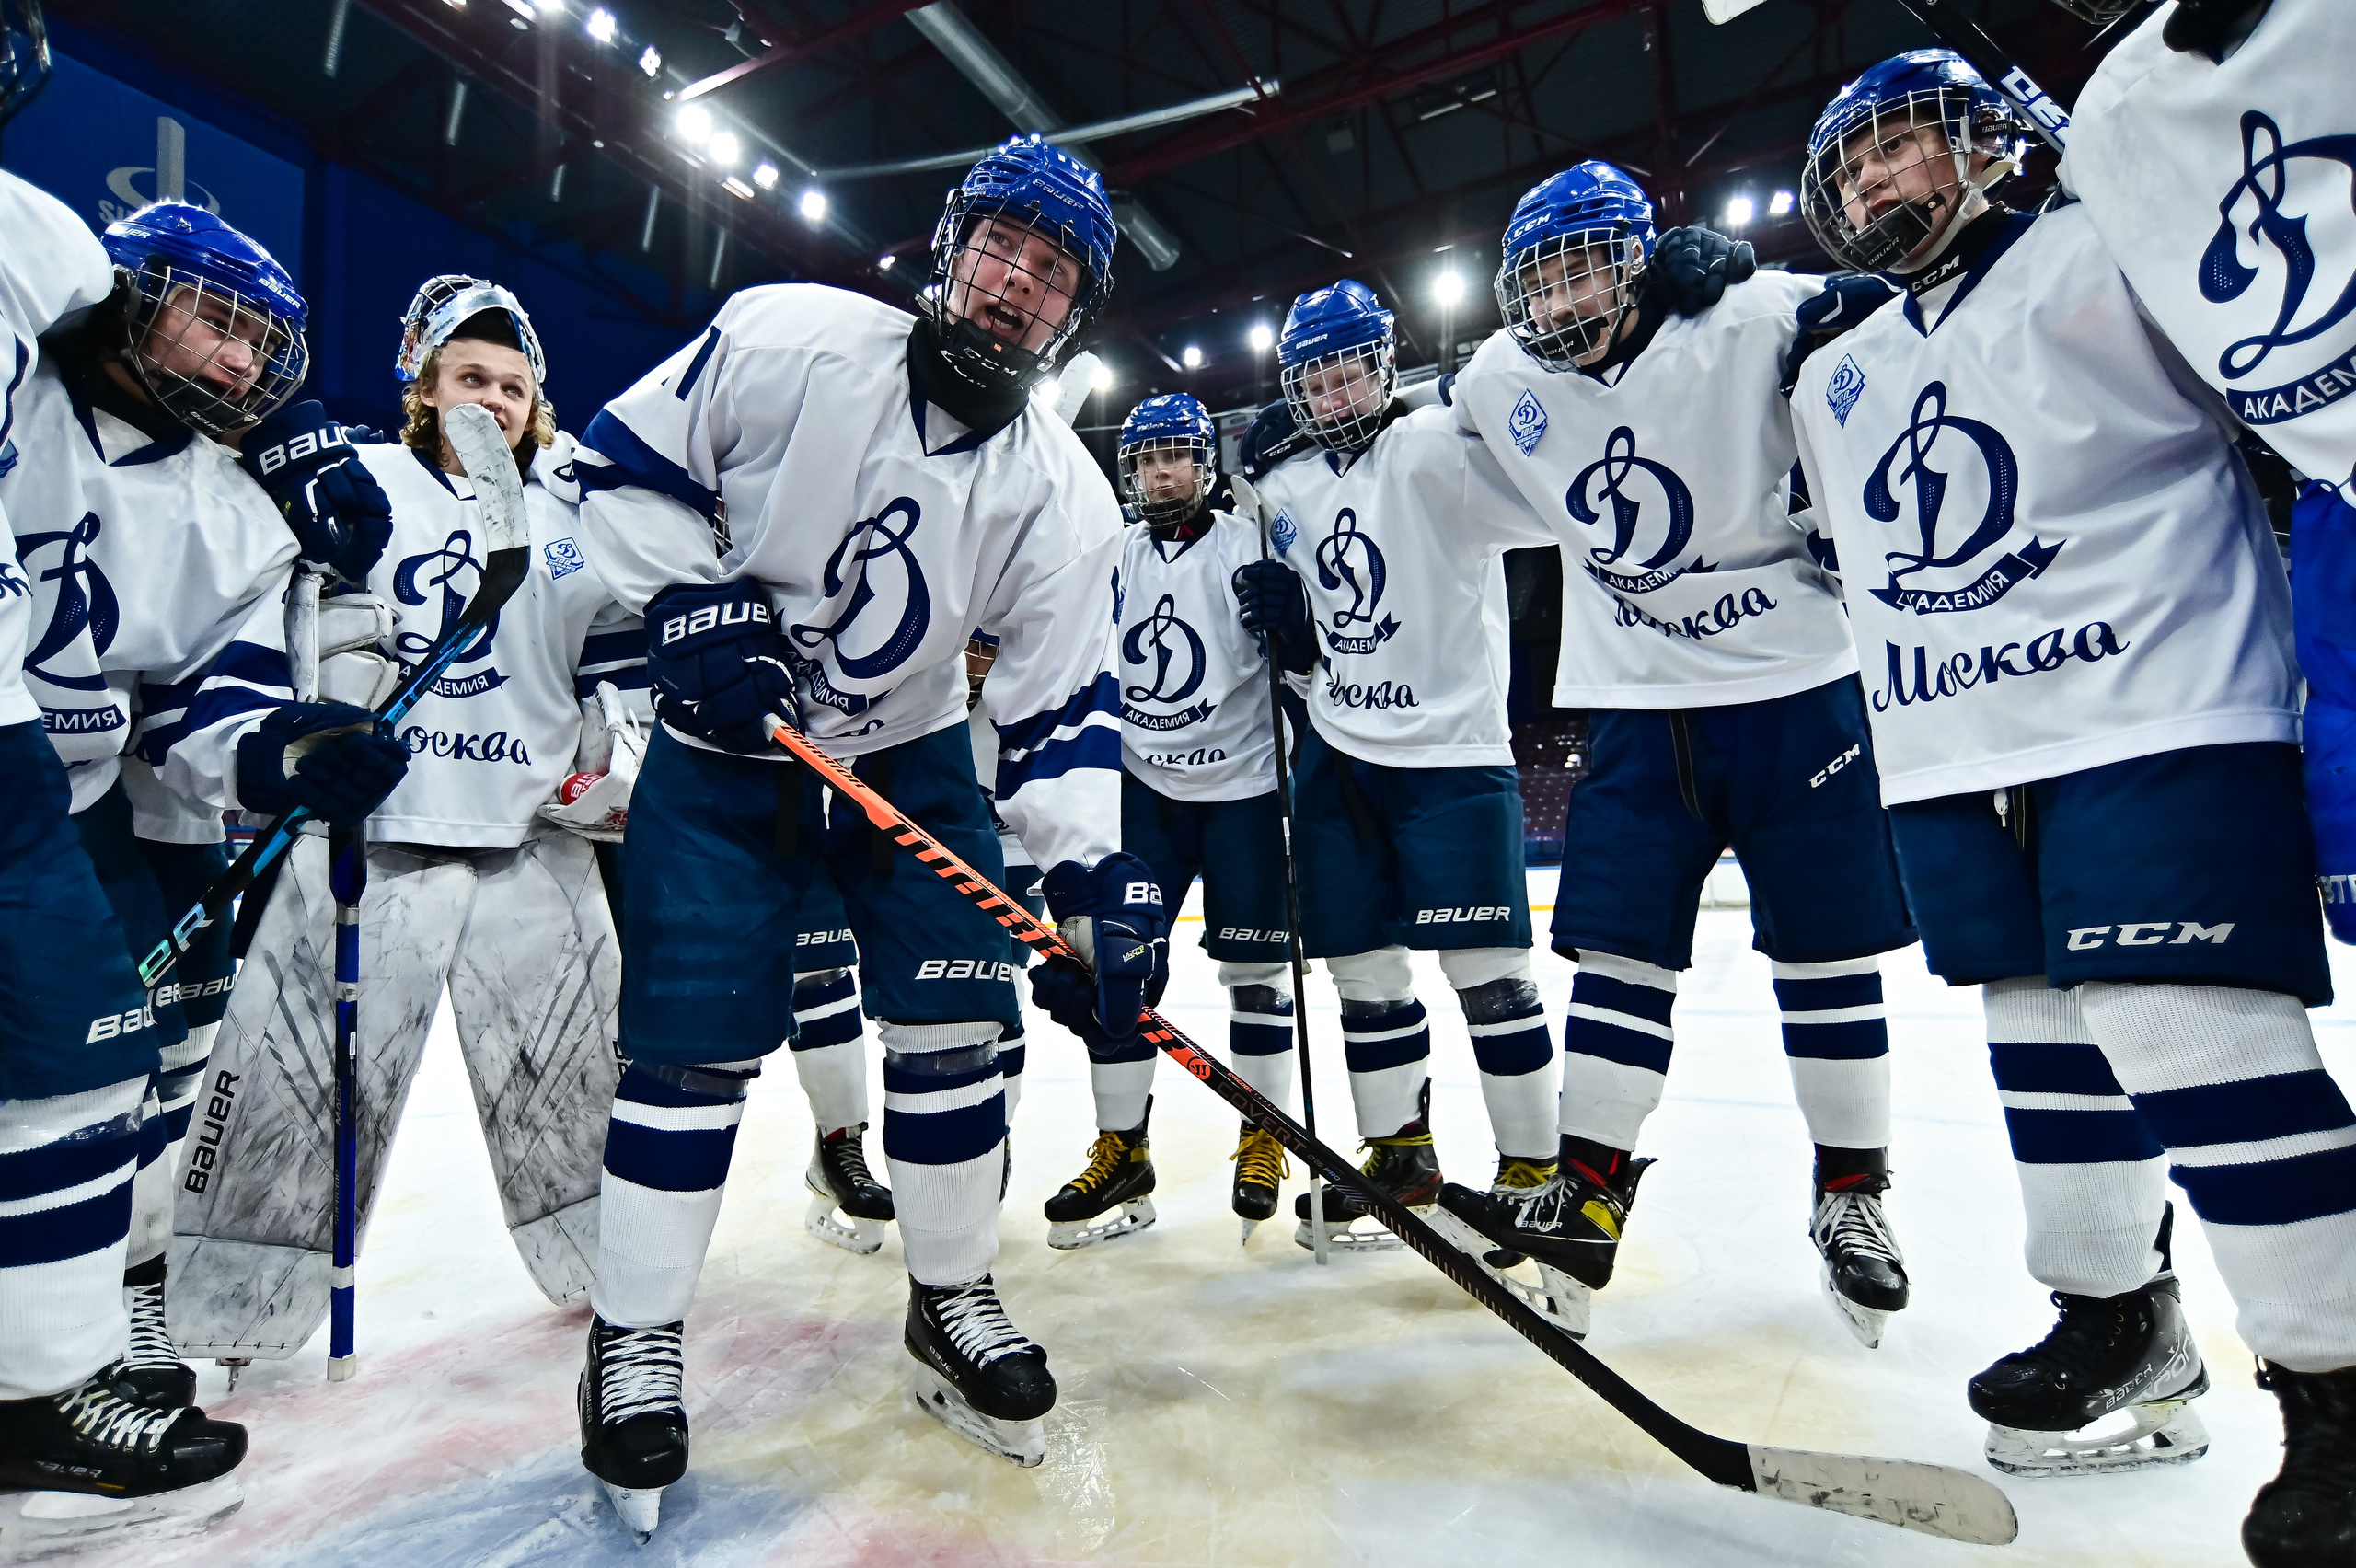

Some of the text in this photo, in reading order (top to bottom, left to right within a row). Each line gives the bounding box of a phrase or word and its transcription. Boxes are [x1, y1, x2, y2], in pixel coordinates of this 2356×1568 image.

[1031, 178, 1086, 212] BAUER
[1513, 213, 1552, 238] CCM
[1867, 236, 1900, 266] BAUER
[1911, 254, 1960, 293] CCM
[258, 277, 302, 309] BAUER
[1295, 333, 1329, 350] BAUER
[2243, 355, 2356, 420] АКАДЕМ
[190, 410, 226, 434] BAUER
[259, 426, 346, 476] BAU
[1268, 444, 1292, 457] CCM
[1905, 570, 2010, 613] КАДЕМИЯ
[662, 601, 771, 646] BAUE
[398, 663, 490, 697] АДЕМИЯ
[1872, 620, 2131, 713] Москва
[1126, 709, 1191, 731] АКАДЕМИЯ
[401, 725, 532, 767] осква
[780, 725, 866, 789] WARRIOR
[1808, 743, 1860, 789] CCM
[964, 866, 996, 891] COVERT
[1415, 905, 1511, 925] BAUER
[796, 928, 854, 947] BAUE
[2066, 921, 2235, 951] CCM
[914, 959, 1013, 984] BAUE
[334, 1078, 342, 1127] MACH
[184, 1069, 241, 1195] BAUER
[1217, 1081, 1307, 1151] COVERT
[1322, 1165, 1341, 1182] PRO
[929, 1345, 960, 1380] BAUER
